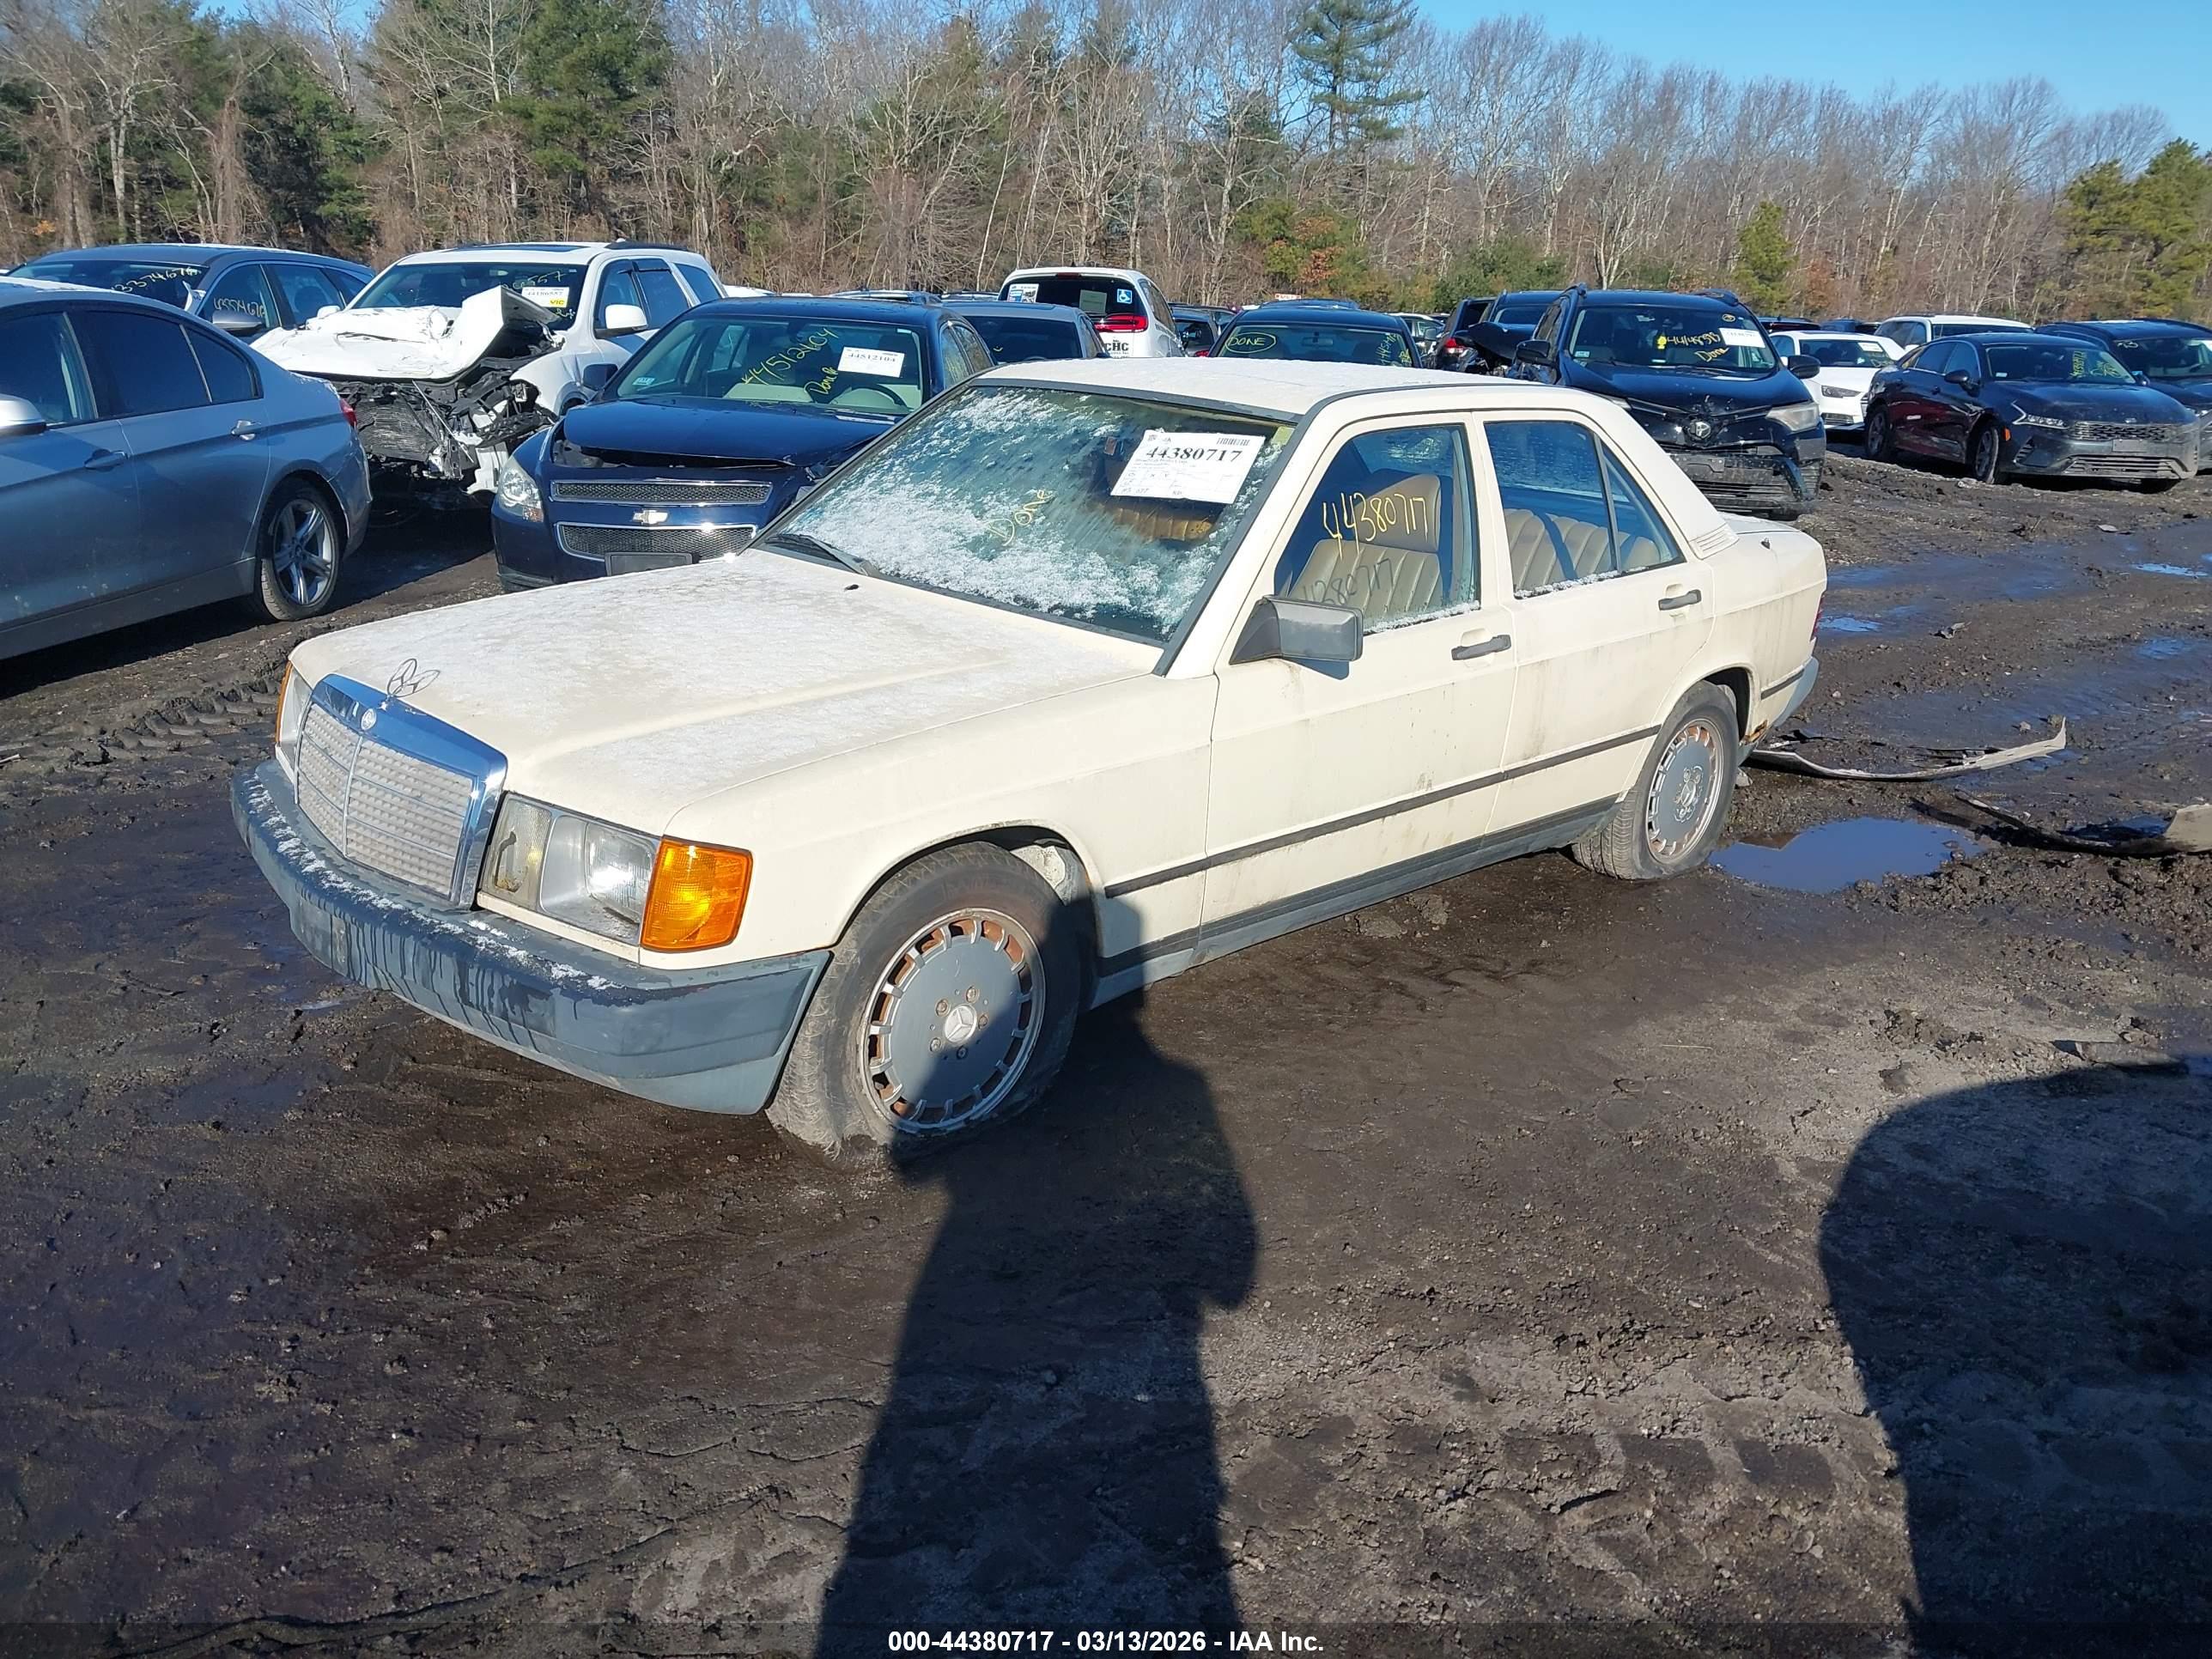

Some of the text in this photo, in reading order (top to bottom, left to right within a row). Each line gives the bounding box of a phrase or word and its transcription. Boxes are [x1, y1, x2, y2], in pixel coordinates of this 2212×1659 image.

[1228, 336, 1266, 347] DONE
[1146, 446, 1243, 462] 44380717
[1322, 492, 1429, 561] 44380717
